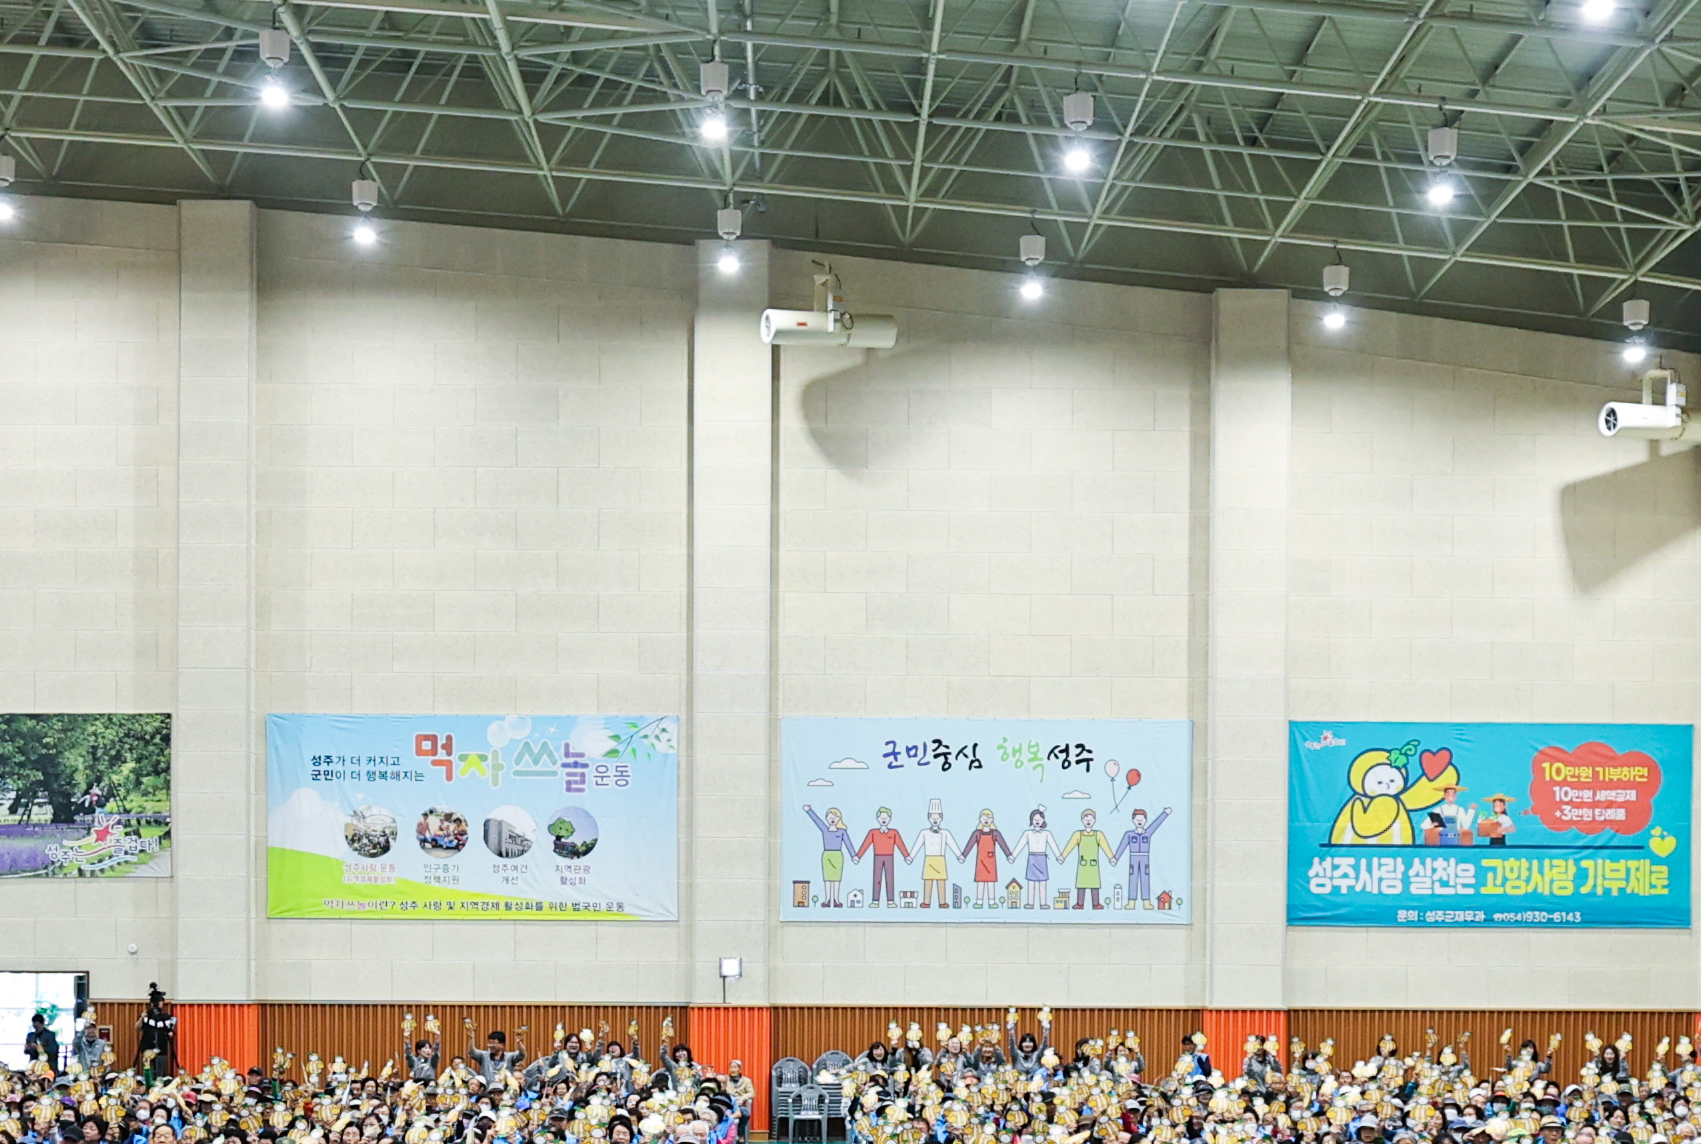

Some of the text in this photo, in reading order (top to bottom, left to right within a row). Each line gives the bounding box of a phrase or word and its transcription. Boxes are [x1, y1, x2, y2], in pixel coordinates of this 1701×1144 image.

[311, 755, 401, 768] 성주가 더 커지고
[882, 738, 983, 772] 군민중심
[311, 769, 426, 783] 군민이 더 행복해지는
[594, 763, 632, 788] 운동
[1541, 762, 1649, 782] 10만원 기부하면
[1553, 786, 1637, 802] 10만원 세액공제
[1554, 805, 1593, 821] +3만원
[423, 863, 460, 874] 인구증가
[554, 864, 591, 875] 지역관광
[423, 875, 460, 885] 정책지원
[500, 875, 519, 886] 개선
[559, 876, 587, 887] 활성화
[1307, 856, 1670, 896] 성주사랑 실천은 고향사랑 기부제로
[399, 900, 419, 911] 성주
[422, 900, 442, 911] 사랑
[459, 901, 500, 911] 지역경제
[503, 901, 544, 912] 활성화를
[548, 901, 567, 912] 위한
[605, 901, 625, 912] 운동
